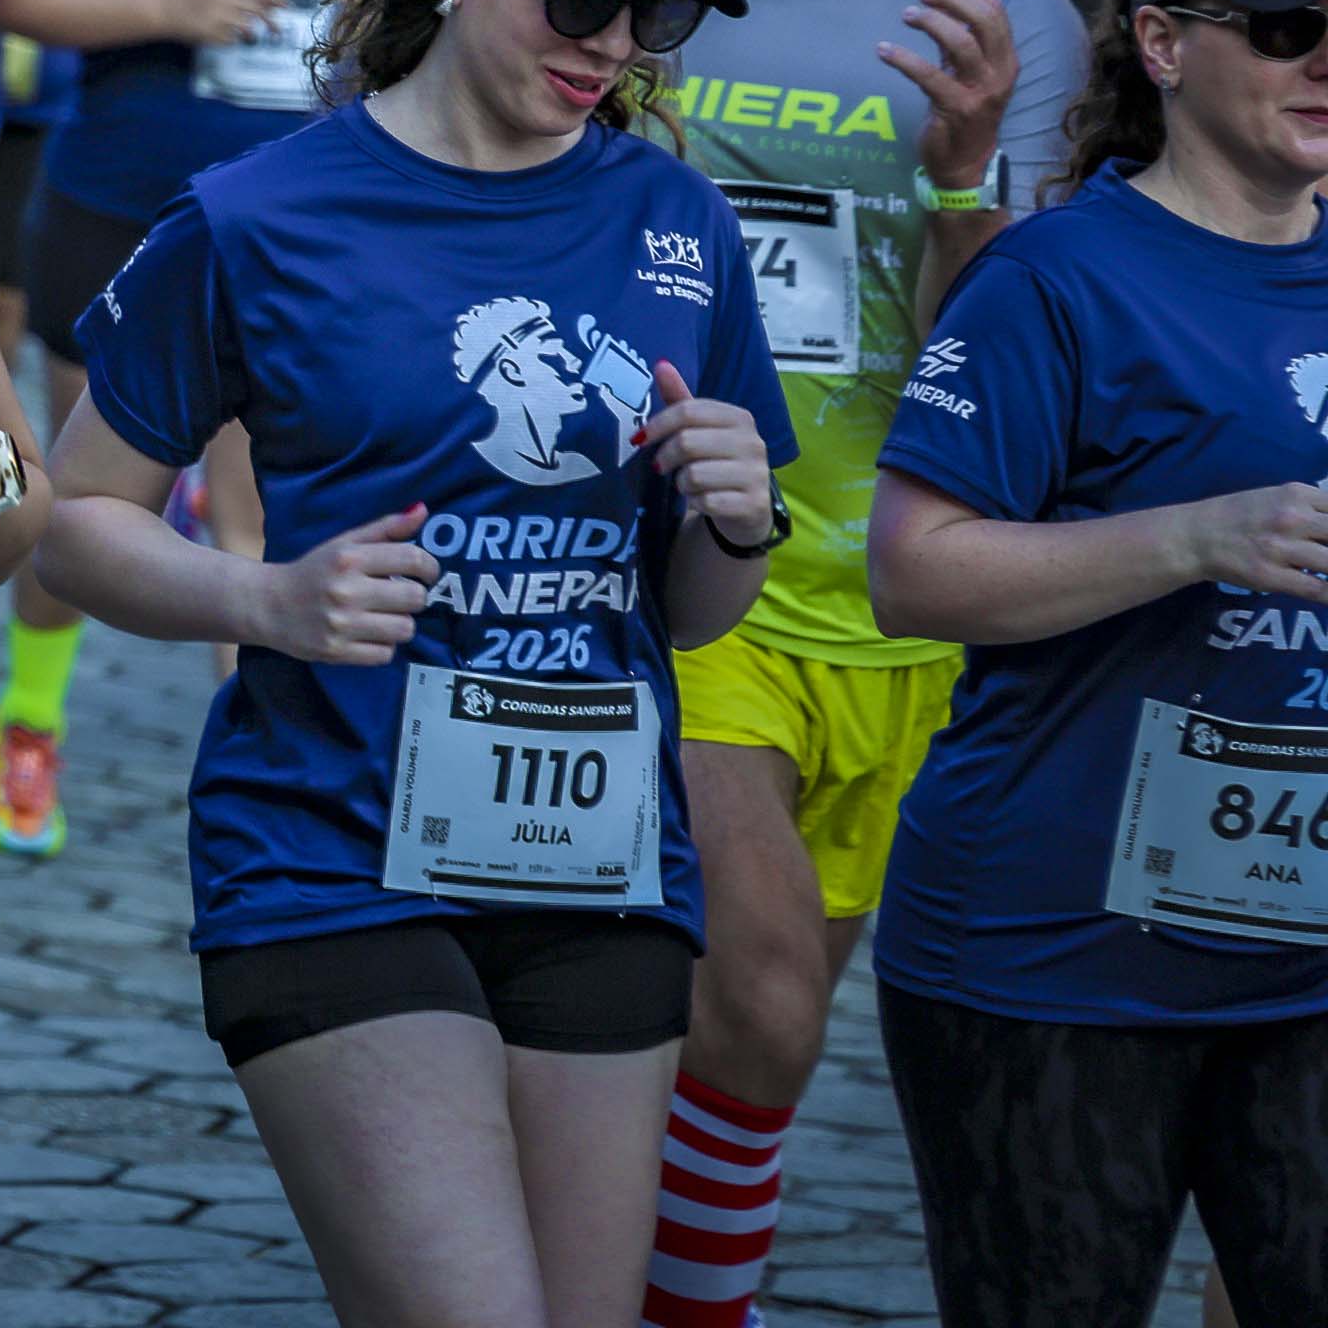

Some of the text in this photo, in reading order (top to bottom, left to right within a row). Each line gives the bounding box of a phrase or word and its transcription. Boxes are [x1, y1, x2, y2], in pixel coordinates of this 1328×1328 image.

[414, 512, 641, 563] ORRID
[471, 623, 593, 671] 2026
[500, 698, 568, 716] CORRIDAS
[1285, 667, 1328, 709] 2
[404, 745, 419, 791] VOLUMES
[1229, 740, 1296, 756] CORRIDAS
[491, 742, 608, 810] 1110
[400, 788, 413, 834] GUARDA
[510, 818, 573, 846] JÚLIA
[1245, 861, 1303, 886] ANA
